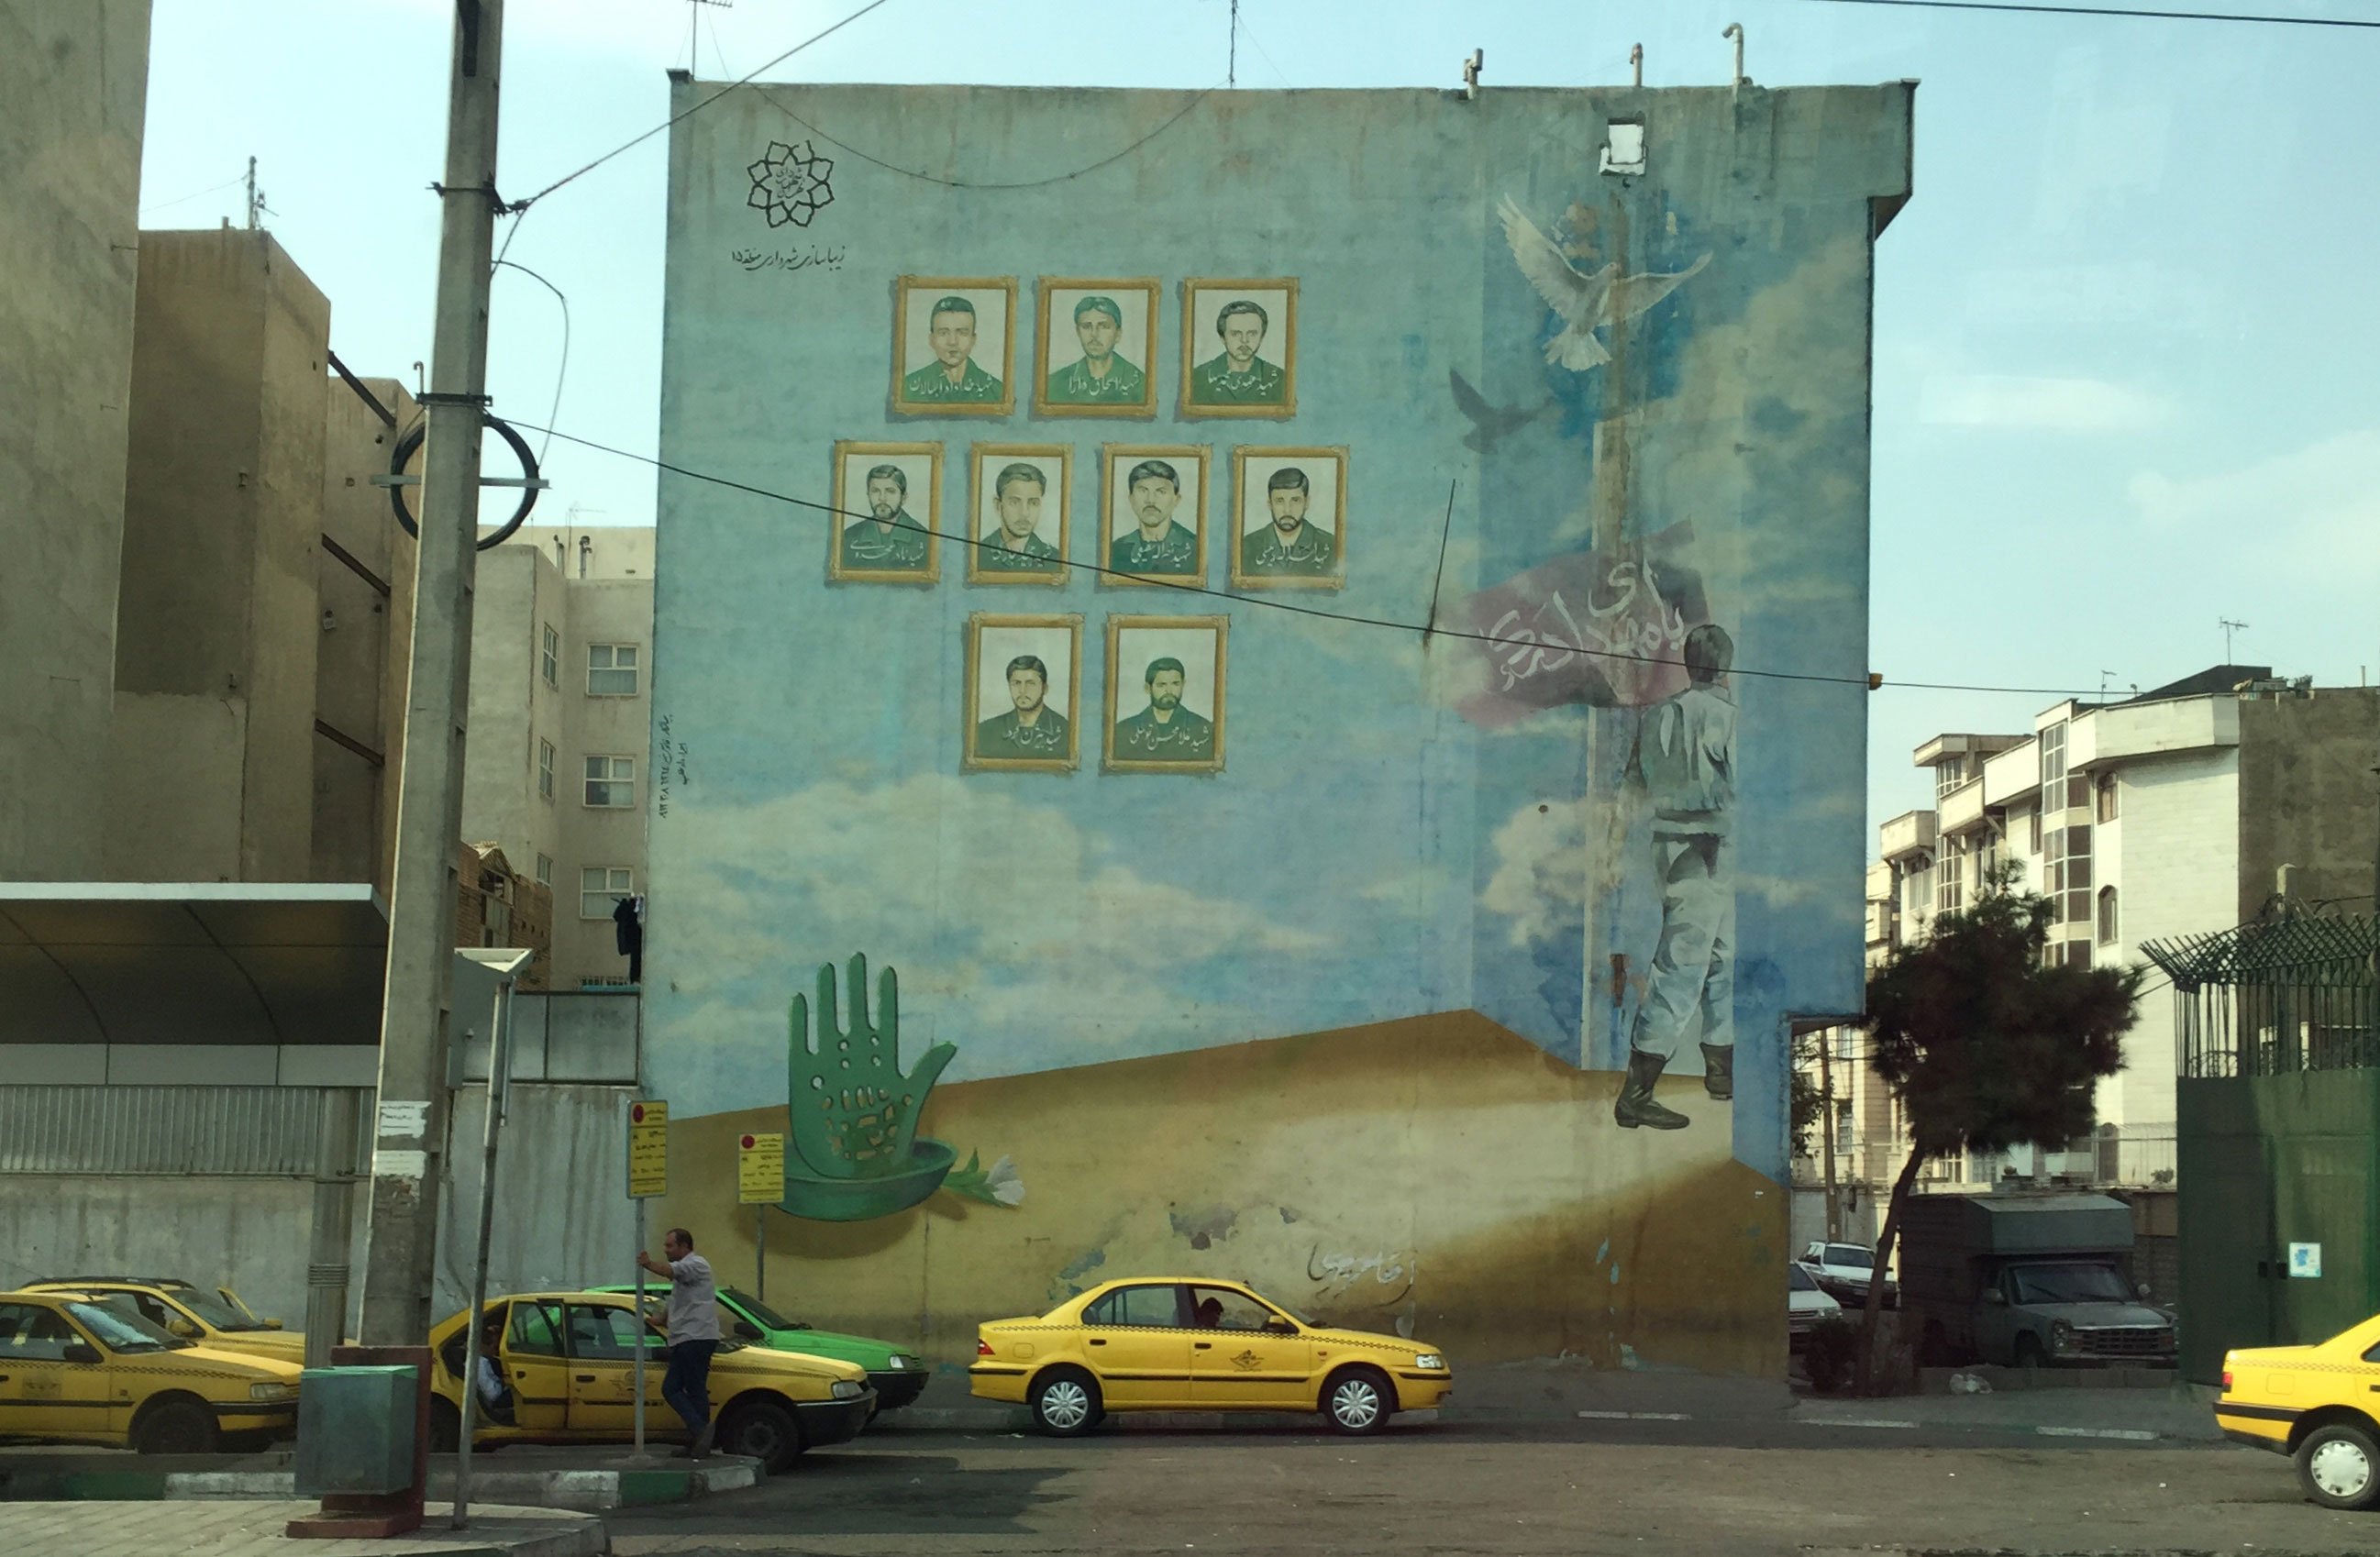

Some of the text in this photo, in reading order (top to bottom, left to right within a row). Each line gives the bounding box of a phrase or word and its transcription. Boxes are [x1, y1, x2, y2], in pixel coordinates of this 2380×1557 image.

[974, 374, 993, 397] شهید
[1119, 370, 1139, 395] شهید
[1256, 370, 1279, 396] شهید
[909, 542, 924, 567] شهید
[1170, 543, 1191, 568] شهید
[1312, 544, 1330, 569] شهید
[1046, 725, 1062, 751] شهید
[1190, 725, 1210, 752] شهید
